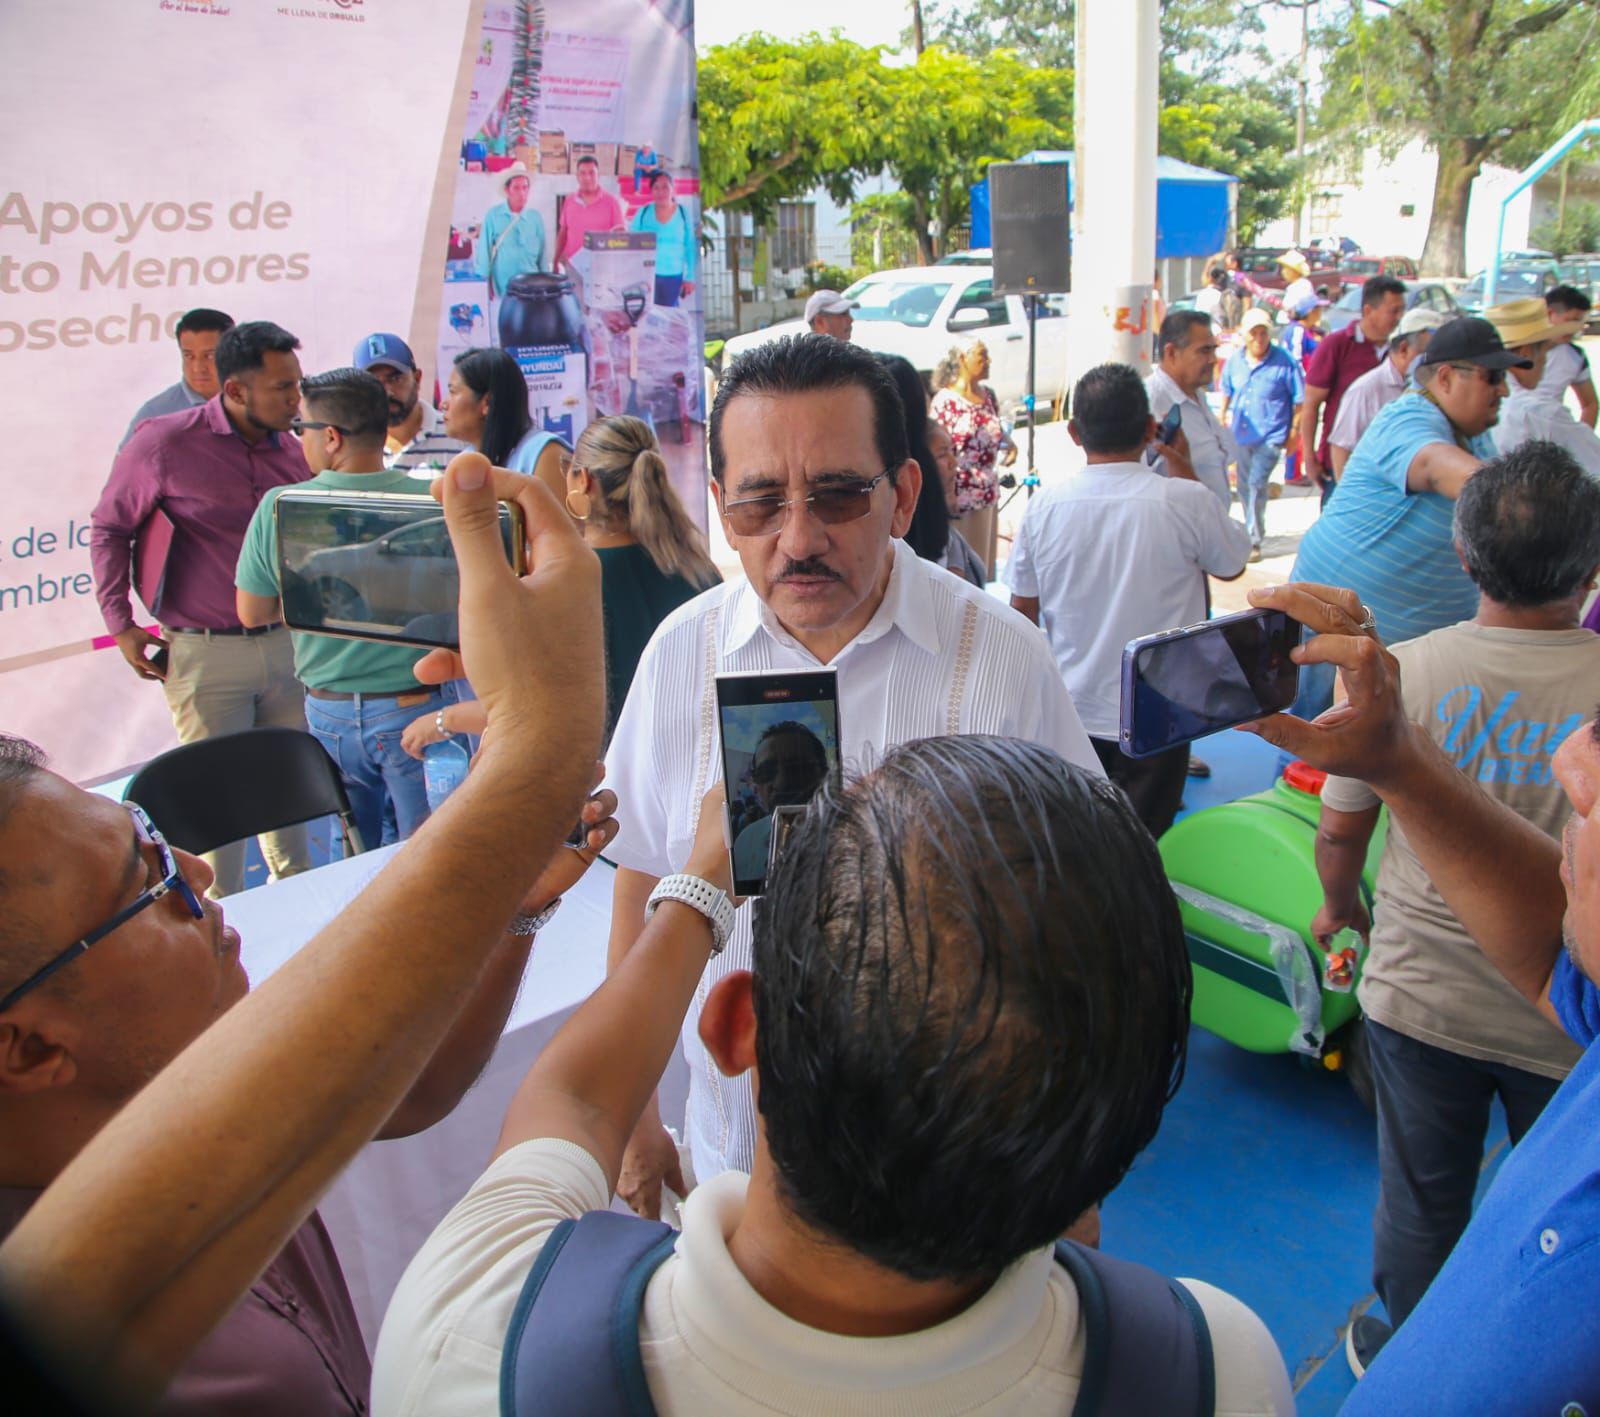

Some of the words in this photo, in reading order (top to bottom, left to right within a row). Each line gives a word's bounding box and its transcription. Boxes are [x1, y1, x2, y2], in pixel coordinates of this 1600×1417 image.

[291, 8, 316, 17] LLENA
[329, 12, 365, 22] ORGULLO
[0, 191, 213, 245] Apoyos
[228, 191, 292, 230] de
[80, 250, 310, 291] Menores
[12, 526, 57, 558] de
